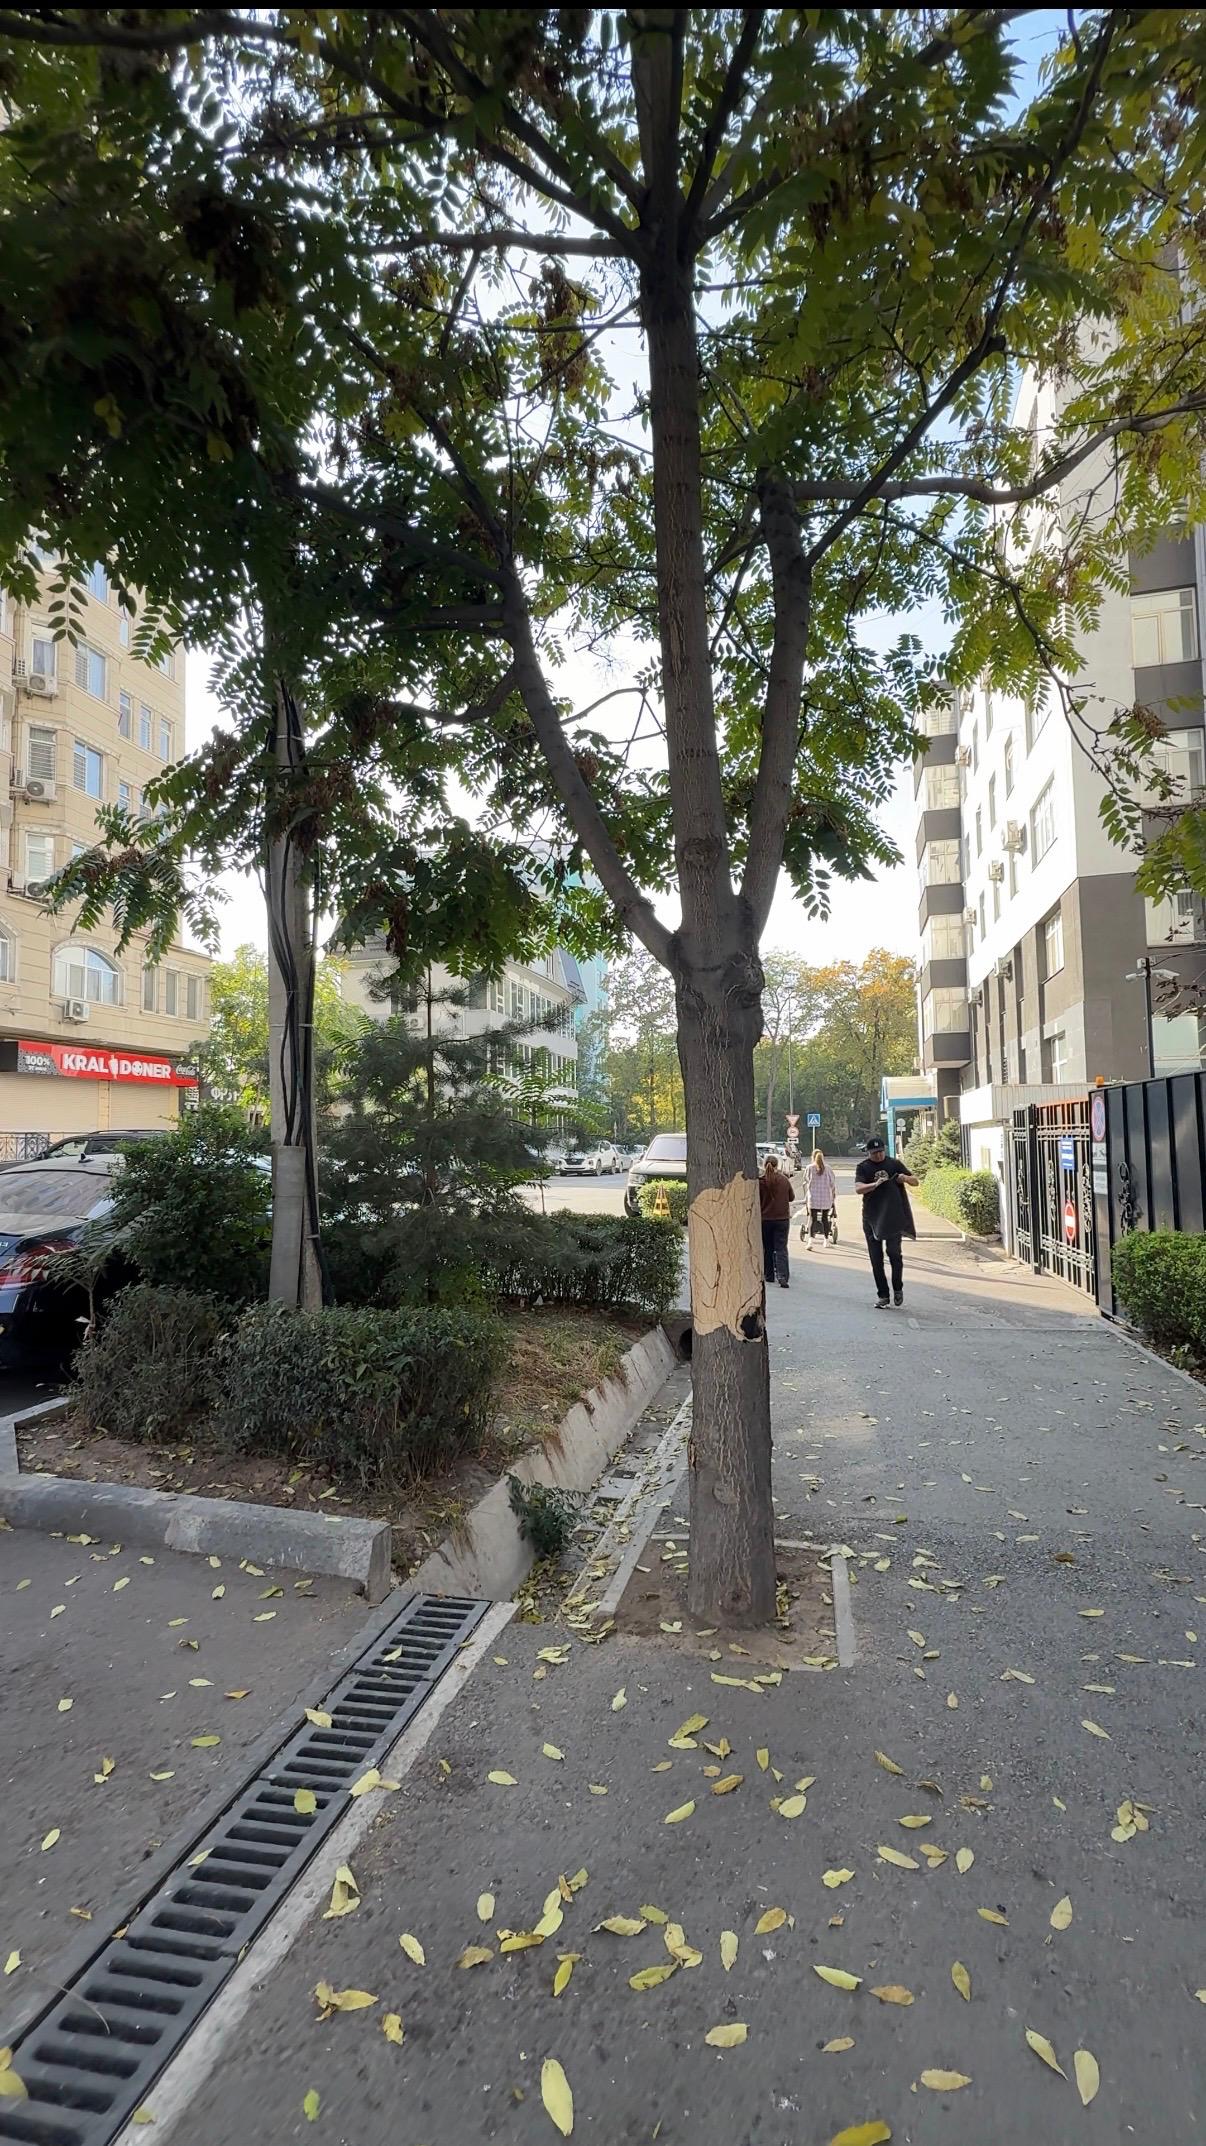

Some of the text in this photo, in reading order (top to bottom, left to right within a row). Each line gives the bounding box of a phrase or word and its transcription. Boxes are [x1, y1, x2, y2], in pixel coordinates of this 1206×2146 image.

[24, 1055, 50, 1066] 100%
[62, 1054, 172, 1079] KRAL DONER
